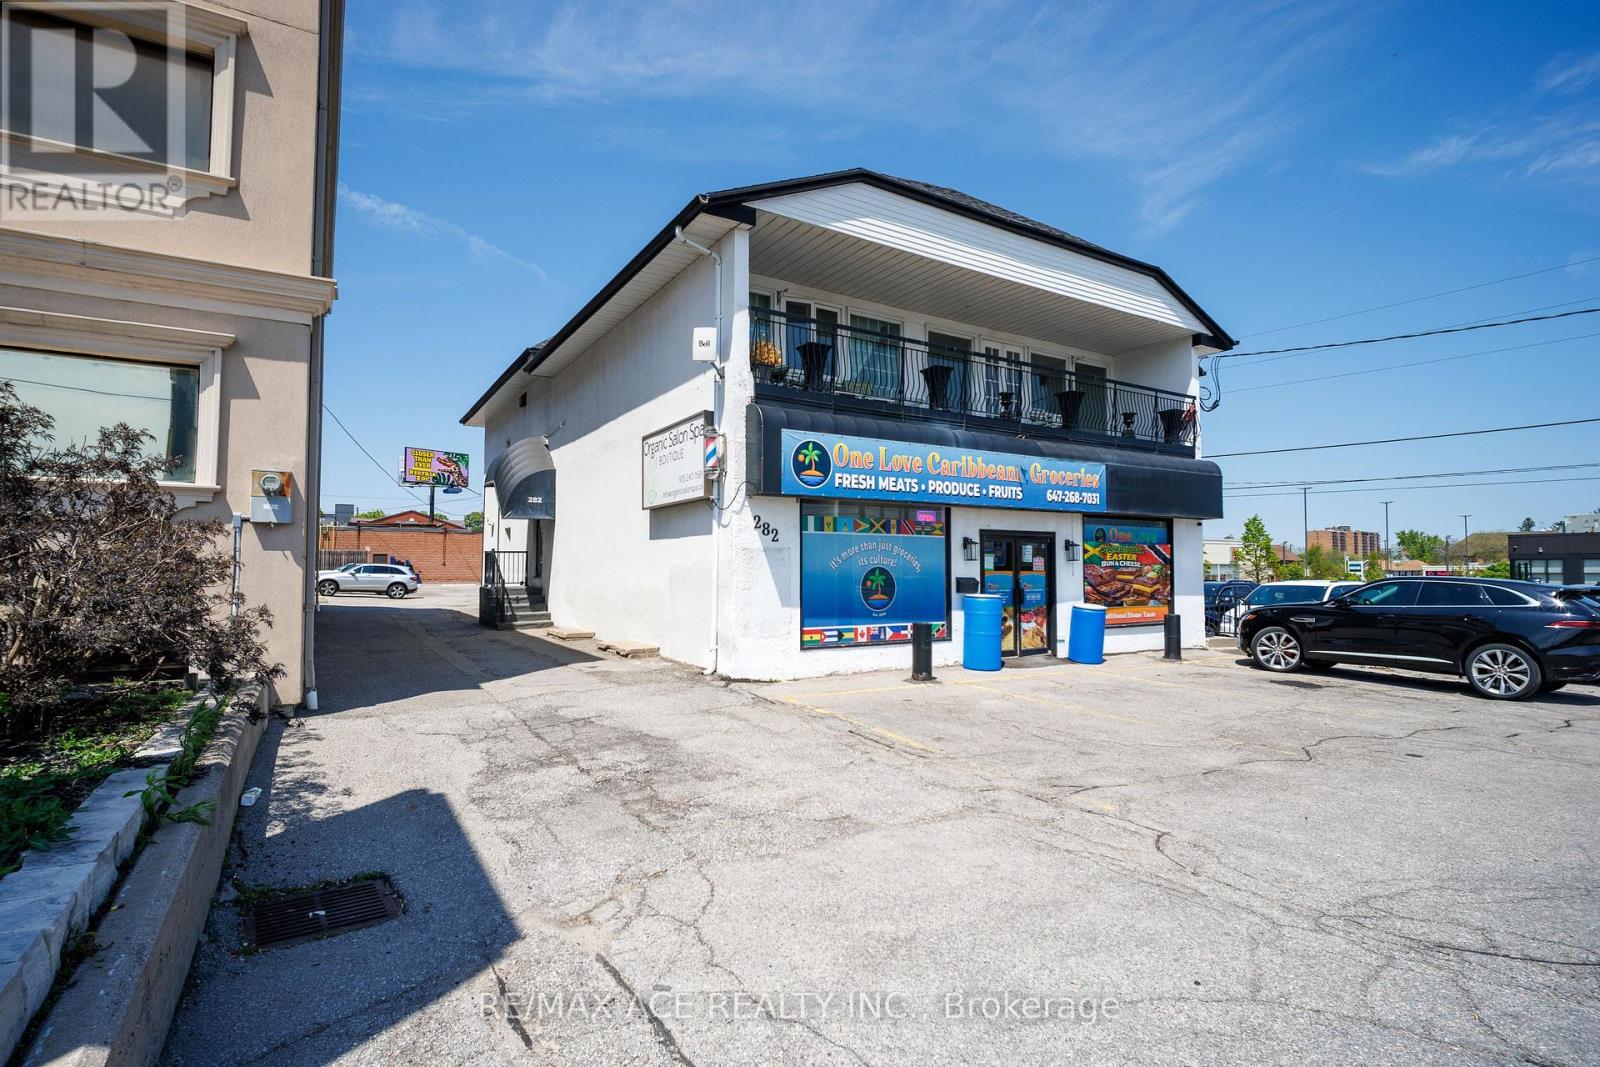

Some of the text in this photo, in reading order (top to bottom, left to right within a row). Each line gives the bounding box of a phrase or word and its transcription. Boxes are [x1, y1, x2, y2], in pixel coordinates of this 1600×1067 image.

[698, 339, 711, 347] Bell
[644, 423, 705, 460] Organic Salon Spa
[412, 450, 434, 458] CLOSER
[414, 455, 432, 463] THAN
[833, 442, 1100, 489] One Love Caribbean Groceries
[834, 472, 1023, 501] FRESH MEATS PRODUCE FRUITS
[527, 496, 543, 504] 282
[1045, 489, 1100, 505] 647-268-7031
[753, 514, 779, 542] 282
[828, 556, 842, 570] It's
[841, 546, 860, 560] more
[860, 541, 877, 552] than
[878, 538, 892, 552] just
[1106, 553, 1138, 561] EASTER
